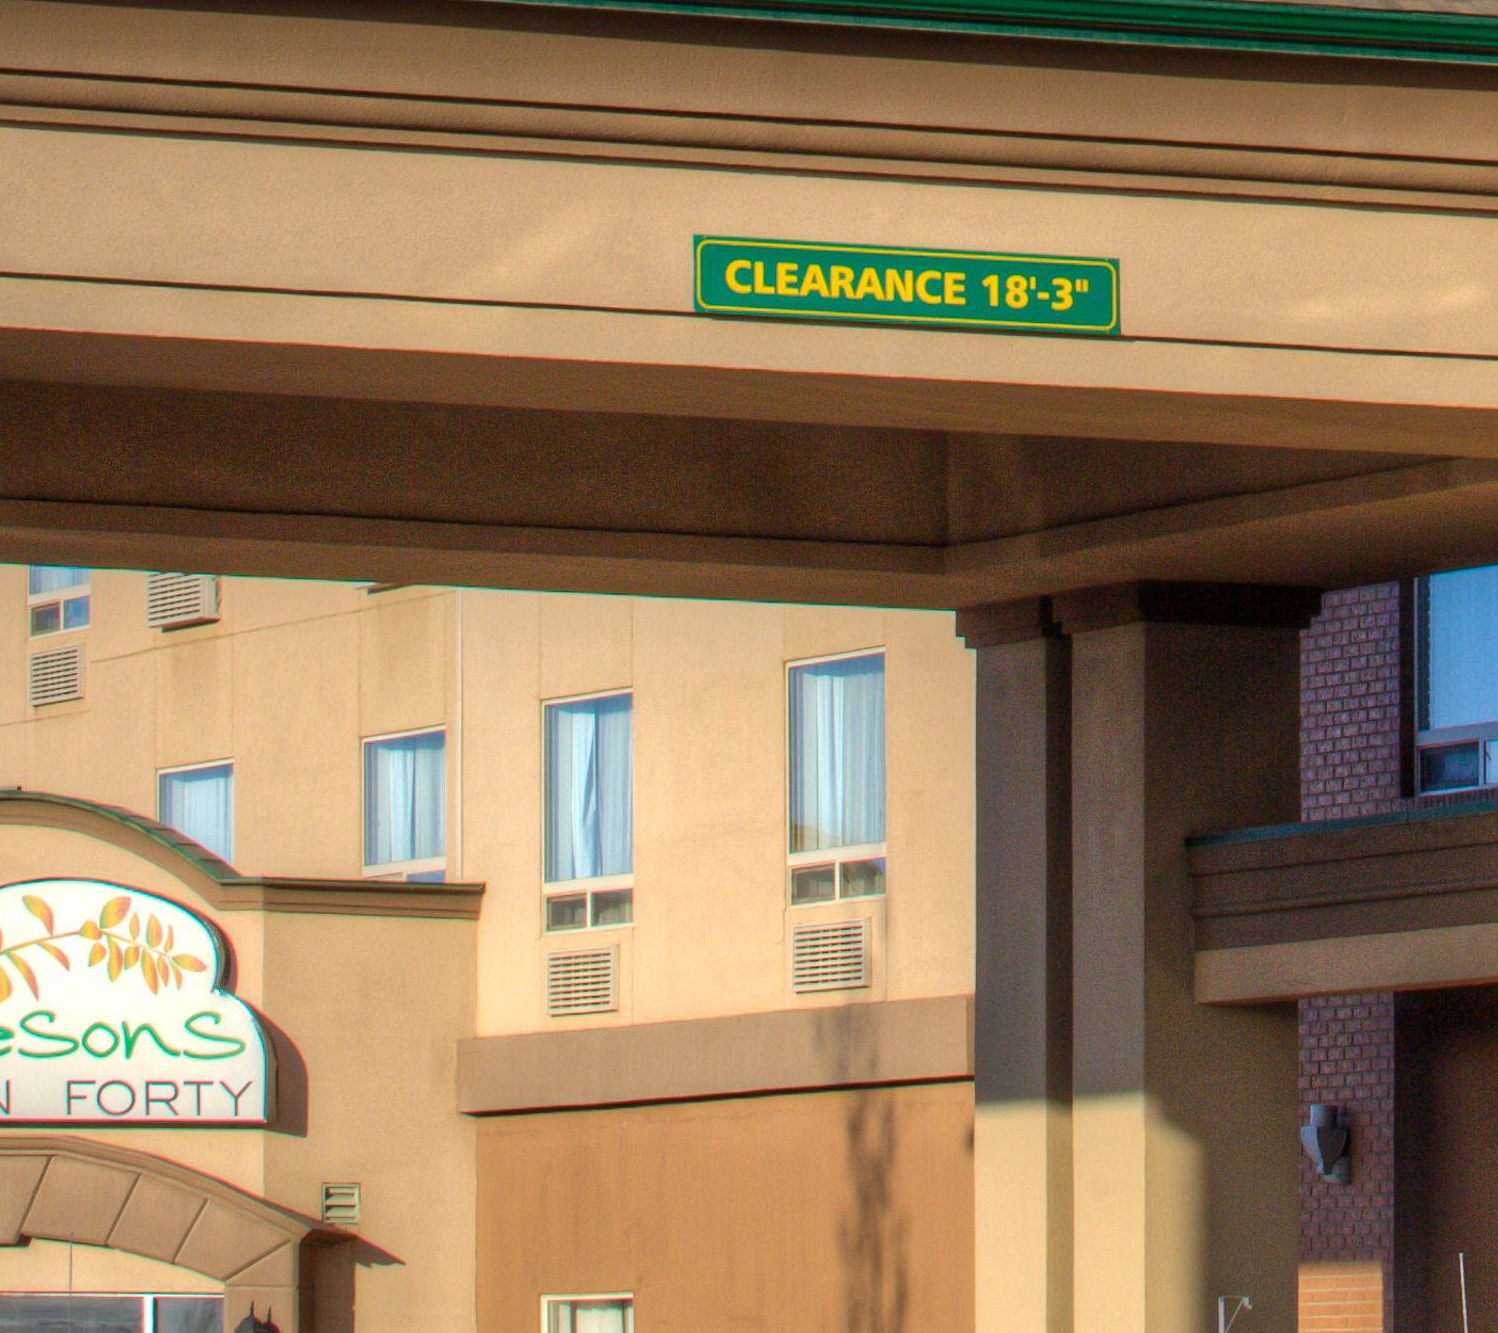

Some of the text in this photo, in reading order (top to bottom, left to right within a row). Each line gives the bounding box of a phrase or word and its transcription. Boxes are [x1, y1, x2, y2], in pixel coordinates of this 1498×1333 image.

[725, 259, 1089, 311] CLEARANCE 18'-3"
[65, 1079, 255, 1117] FORTY
